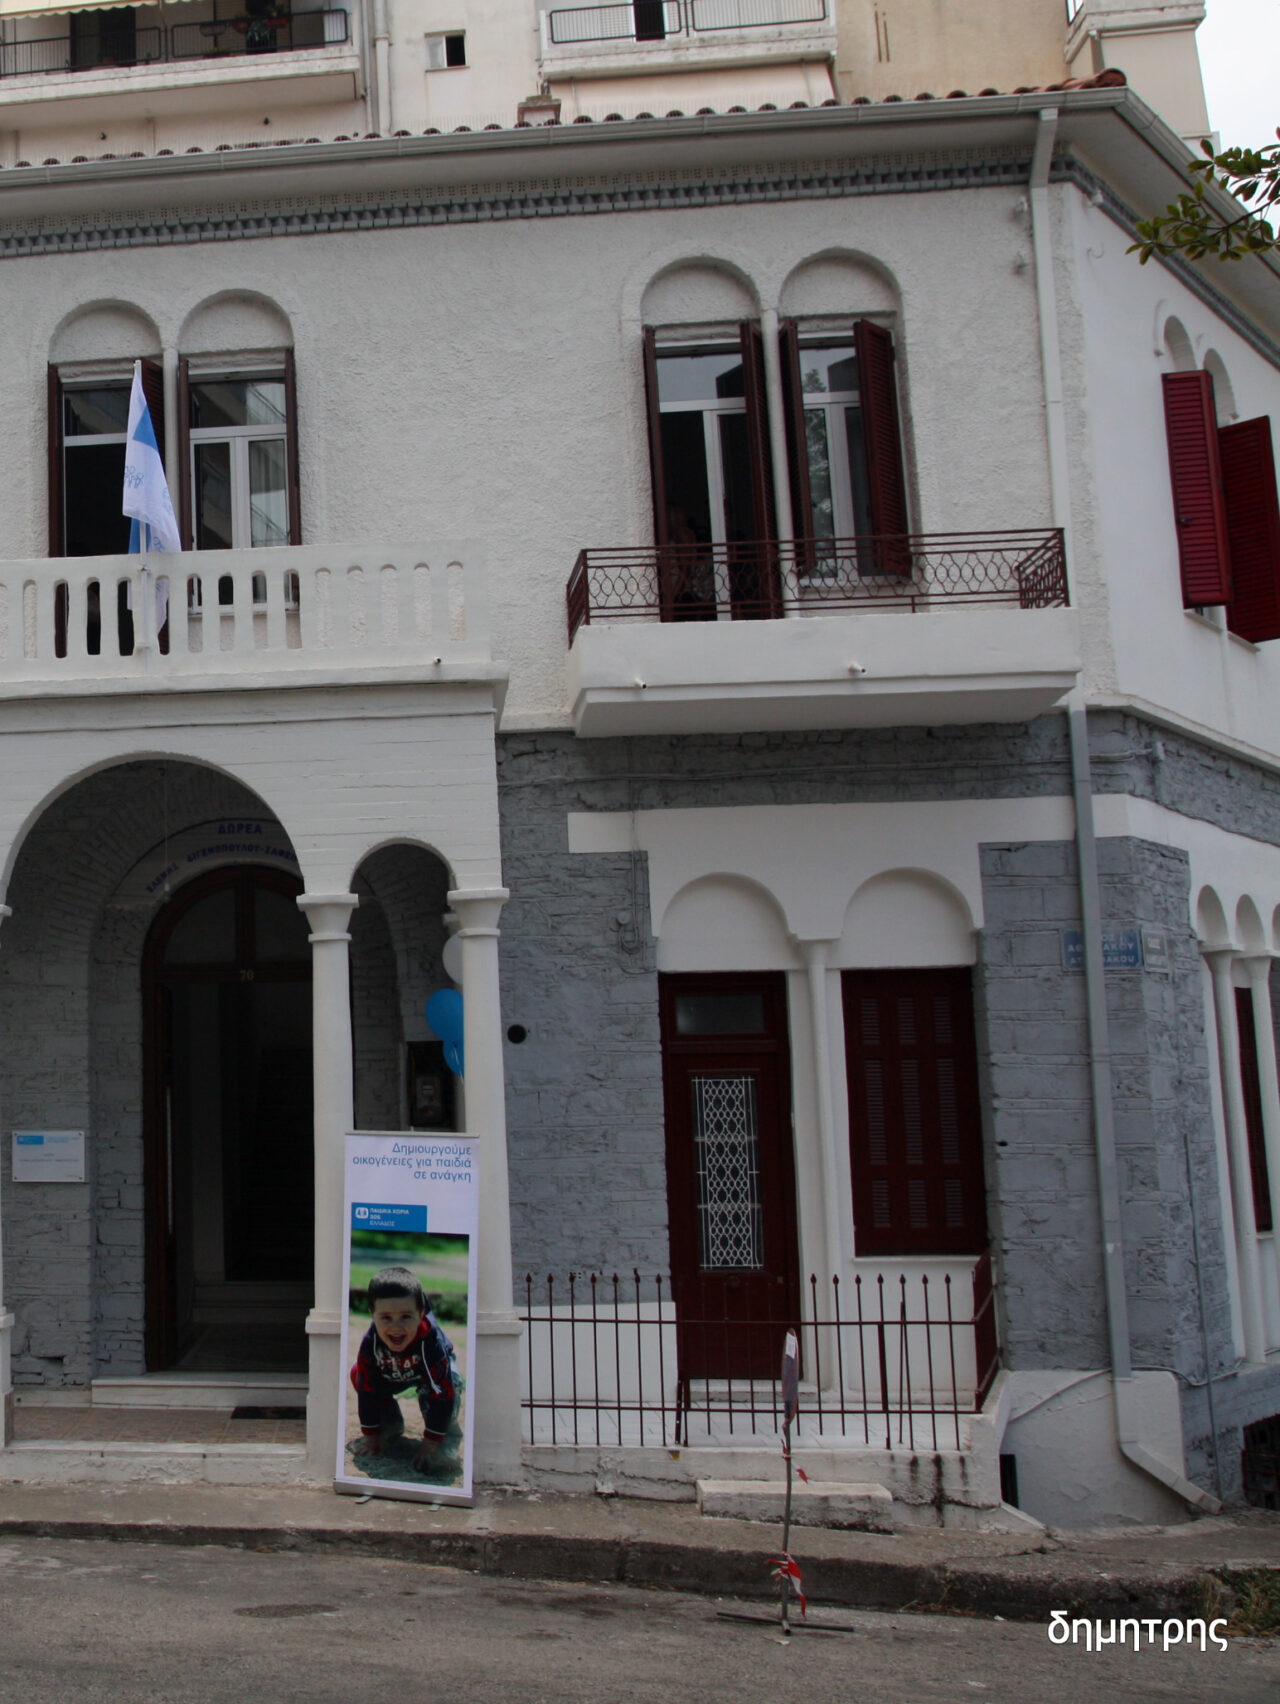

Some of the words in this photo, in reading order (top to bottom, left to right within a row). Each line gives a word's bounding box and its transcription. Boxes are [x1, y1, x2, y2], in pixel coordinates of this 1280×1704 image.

[218, 823, 262, 835] ΔΩΡΕΑ
[392, 1142, 472, 1156] Δημιουργούμε
[352, 1155, 413, 1168] οικογένειες
[416, 1158, 432, 1168] για
[436, 1157, 472, 1168] παιδιά
[413, 1170, 427, 1180] σε
[430, 1170, 472, 1183] ανάγκη
